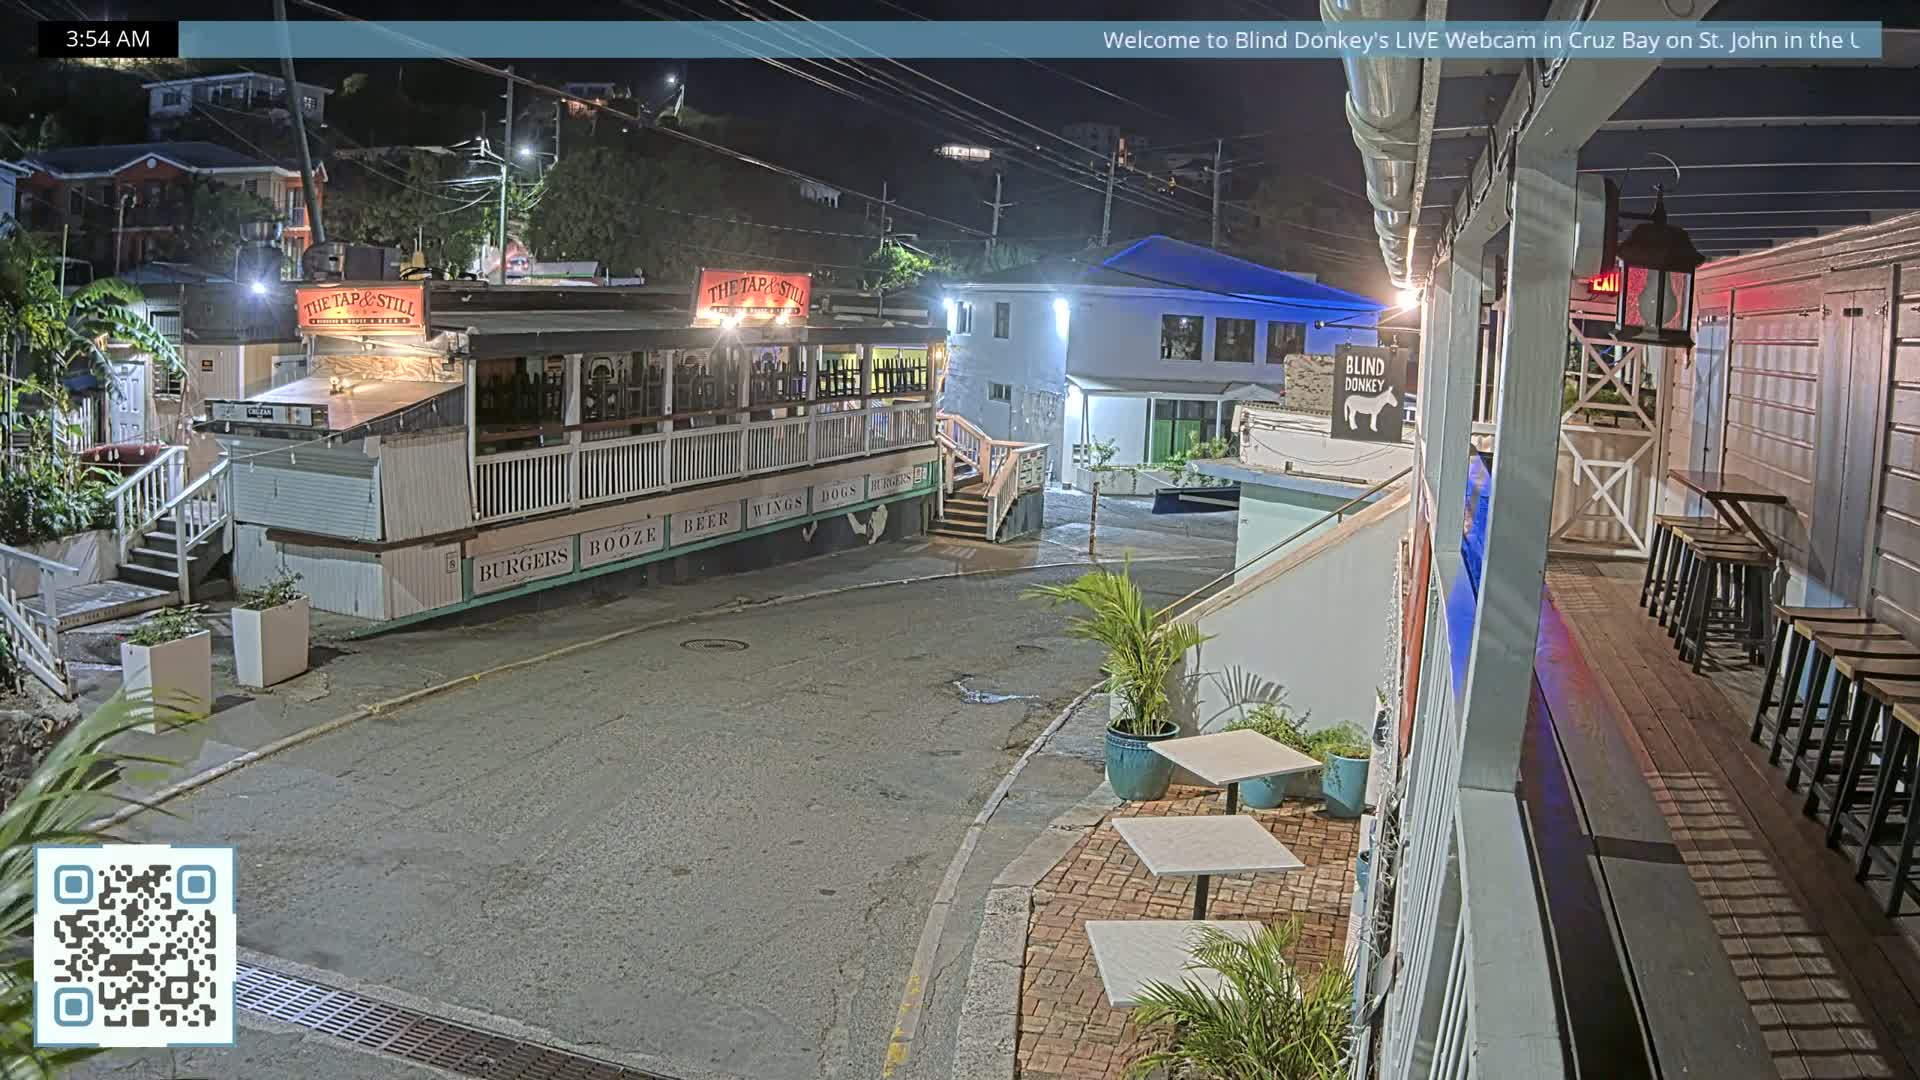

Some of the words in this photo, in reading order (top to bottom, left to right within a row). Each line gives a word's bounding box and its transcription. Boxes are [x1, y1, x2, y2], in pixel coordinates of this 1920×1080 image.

[708, 280, 739, 304] THE
[741, 276, 767, 294] TAP
[764, 276, 780, 295] &
[779, 280, 804, 306] STILL
[304, 297, 332, 317] THE
[331, 292, 360, 307] TAP
[359, 291, 377, 308] &
[376, 293, 416, 317] STILL
[1346, 355, 1385, 376] BLIND
[1345, 376, 1385, 392] DONKEY
[870, 471, 911, 491] BURGERS
[821, 486, 857, 503] DOGS
[753, 495, 802, 518] WINGS
[683, 511, 729, 534] BEER
[589, 527, 657, 557] BOOZE
[479, 548, 569, 583] BURGERS
